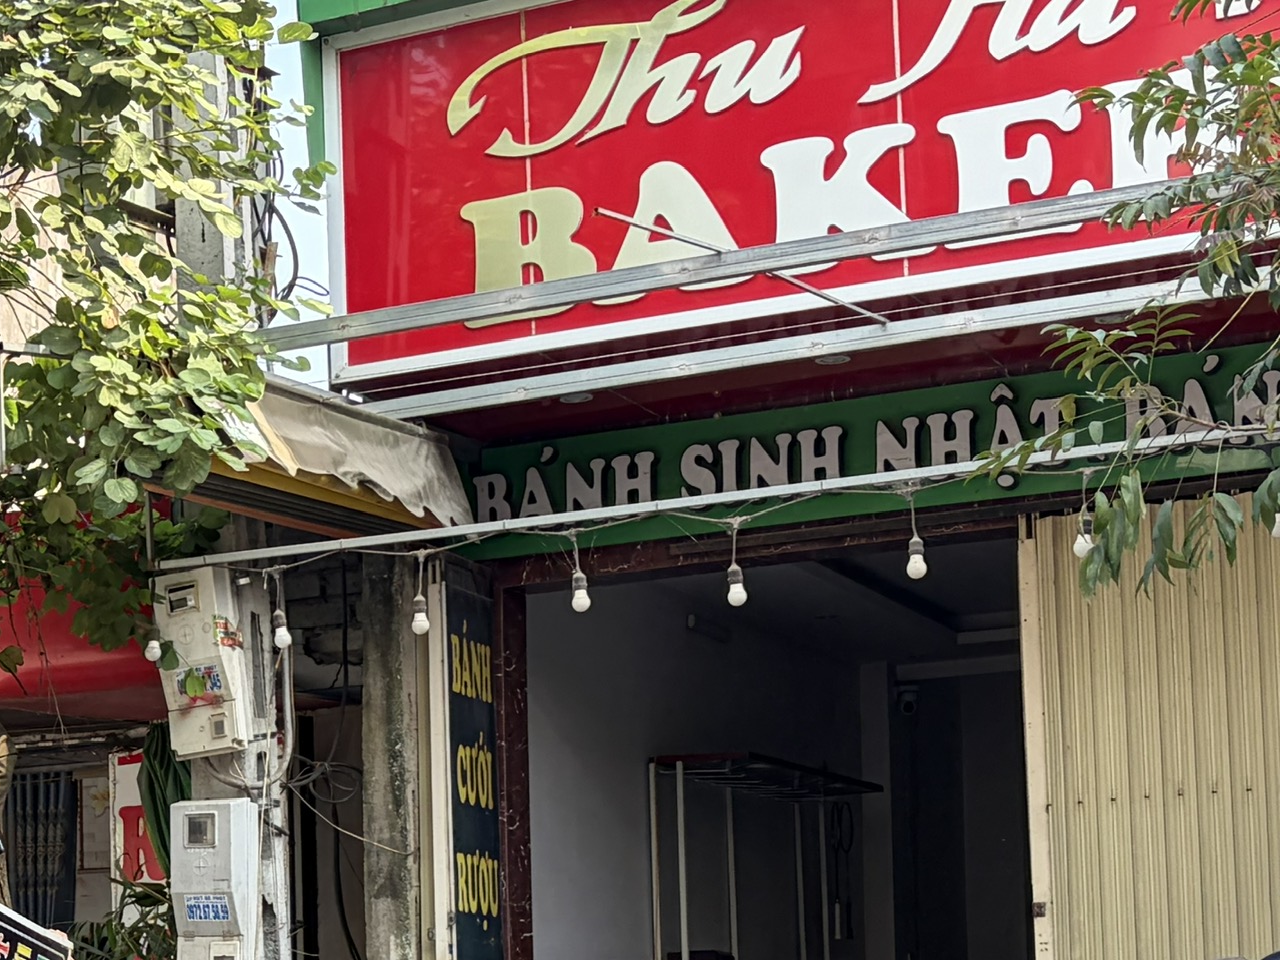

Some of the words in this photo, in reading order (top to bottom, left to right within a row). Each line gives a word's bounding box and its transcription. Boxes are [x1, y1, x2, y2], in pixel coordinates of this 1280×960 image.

[446, 0, 806, 157] Thu
[472, 445, 656, 530] BÁNH
[679, 425, 844, 511] SINH
[875, 382, 1076, 488] NHẬT
[450, 619, 493, 704] BÁNH
[456, 730, 494, 810] CƯỚI
[456, 849, 499, 931] RƯỢU
